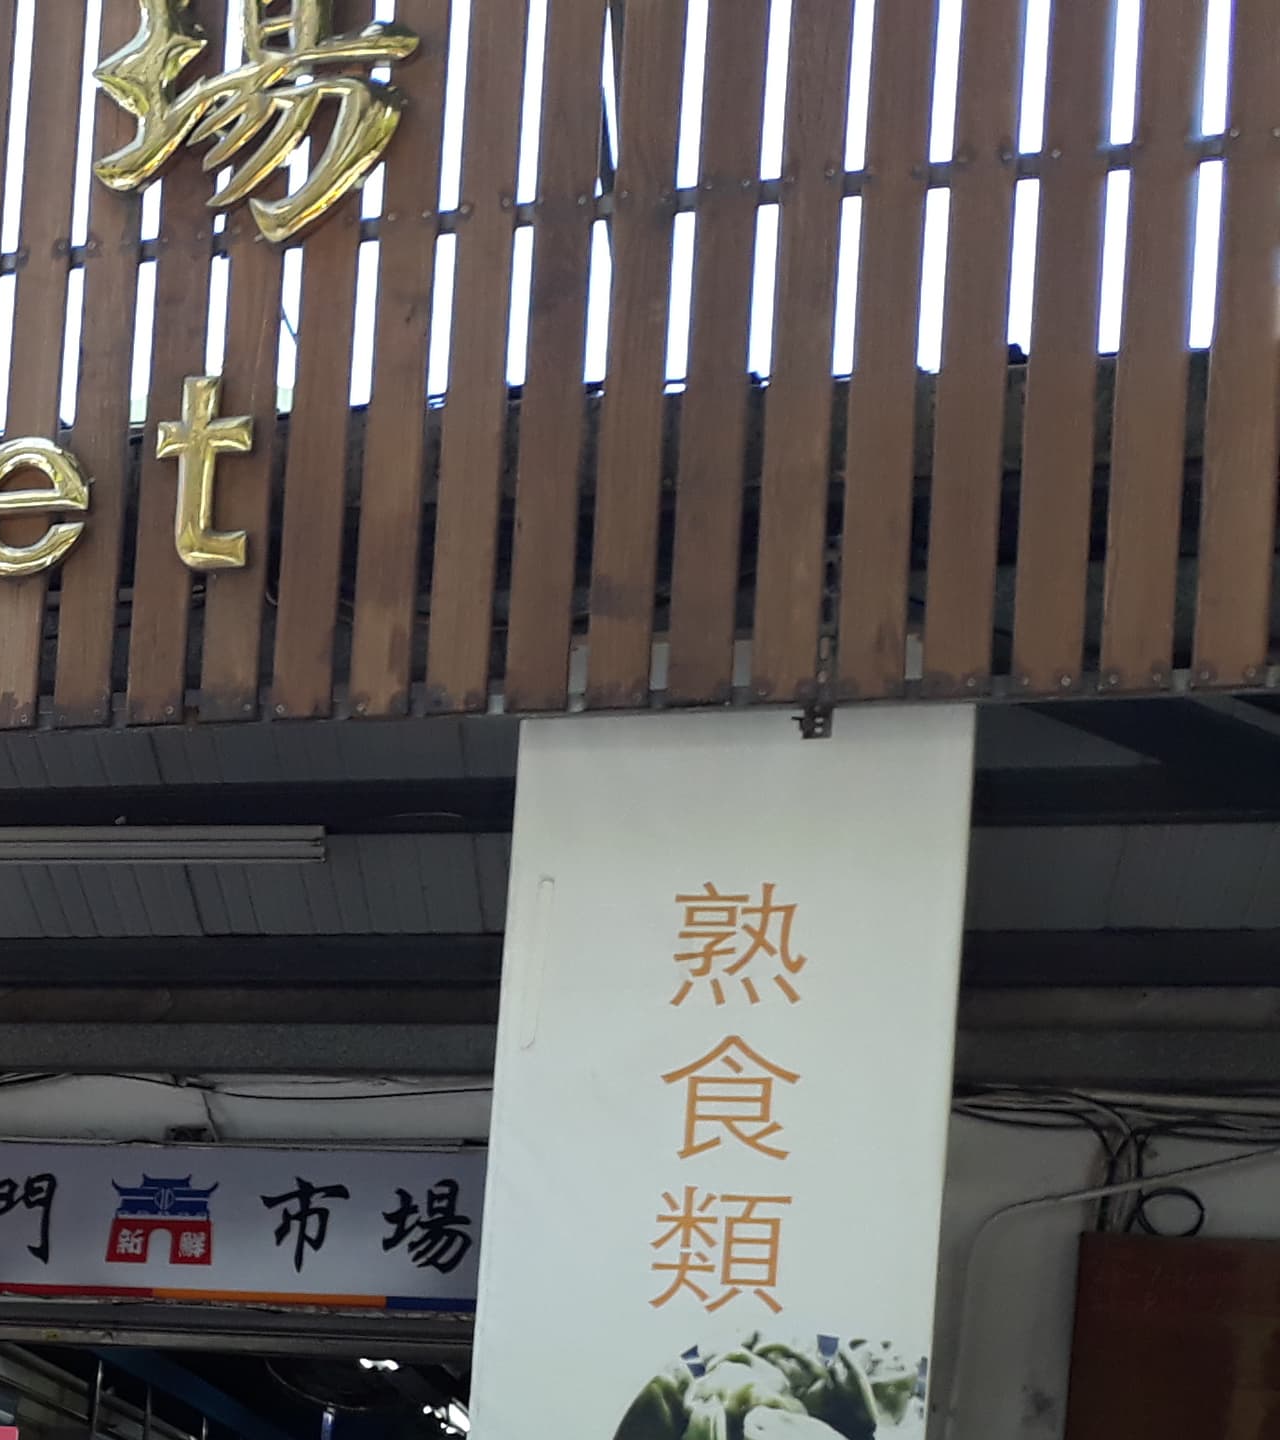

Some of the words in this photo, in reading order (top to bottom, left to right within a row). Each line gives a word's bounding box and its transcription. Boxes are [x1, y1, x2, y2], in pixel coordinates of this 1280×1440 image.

[649, 880, 807, 1314] 熟食類
[116, 1228, 209, 1258] 新鮮
[262, 1177, 475, 1274] 市場
